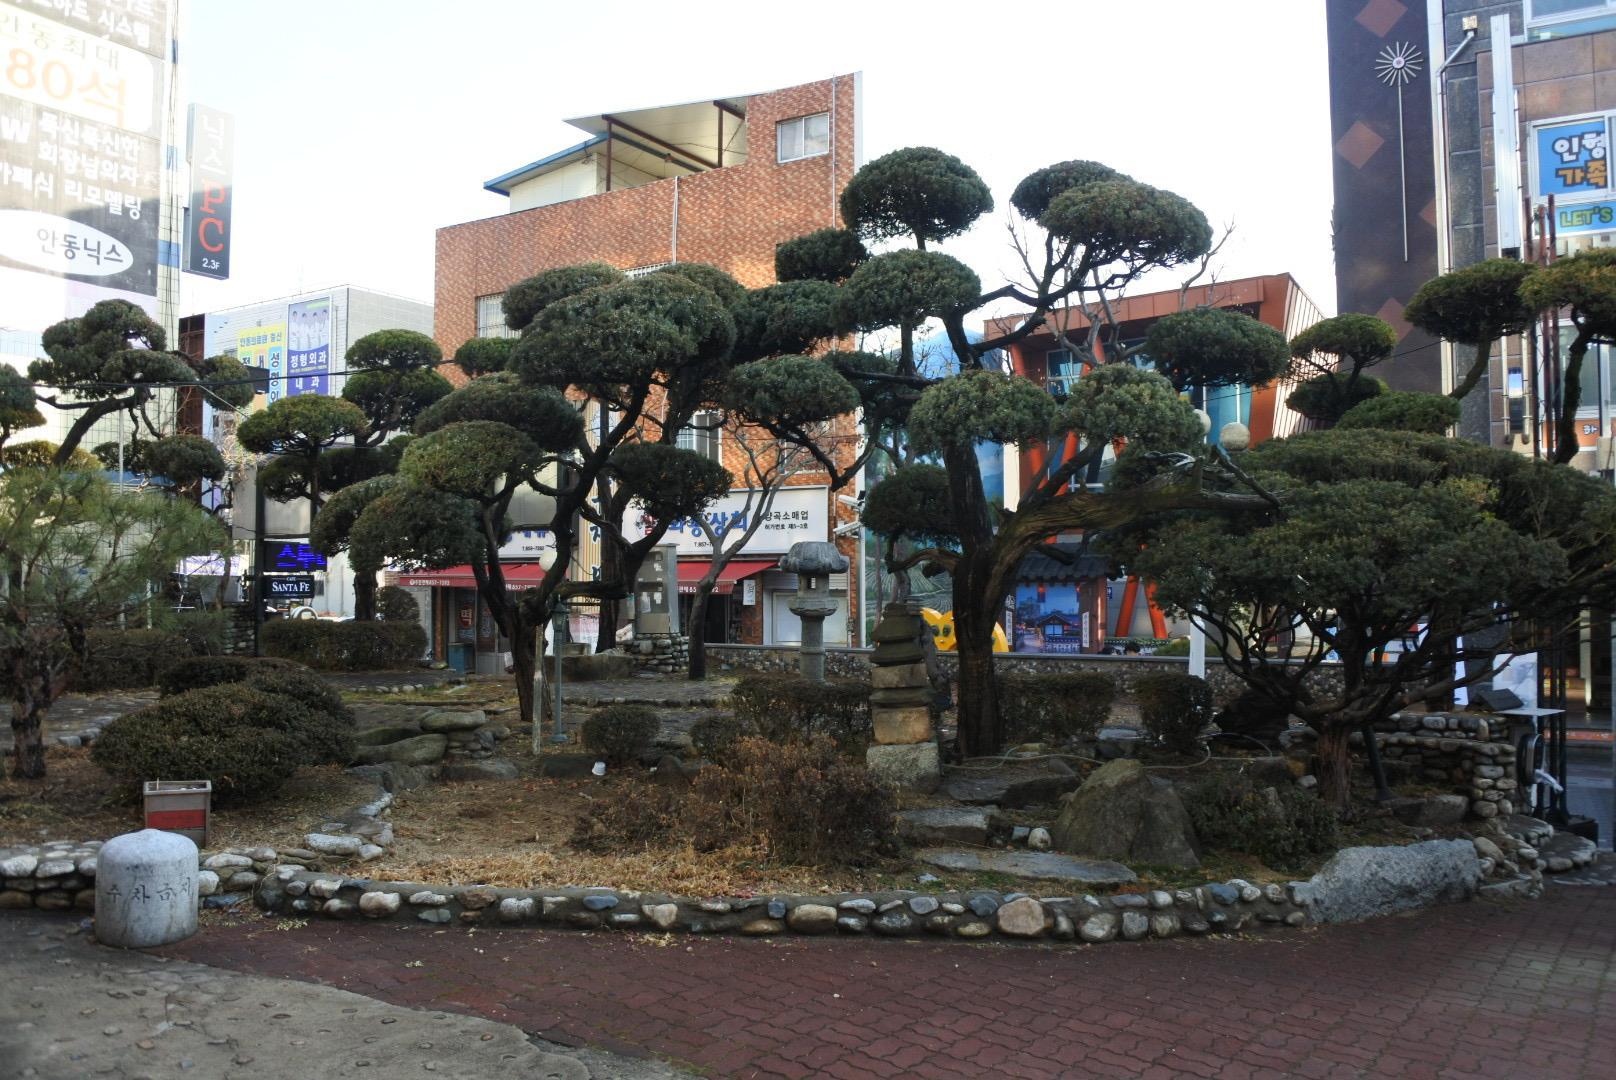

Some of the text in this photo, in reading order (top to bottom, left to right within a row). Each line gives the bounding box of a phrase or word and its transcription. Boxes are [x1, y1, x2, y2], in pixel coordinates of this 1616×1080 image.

[1555, 160, 1607, 188] 가족
[64, 178, 141, 220] 리모델링
[198, 177, 226, 253] PC
[1560, 206, 1613, 227] LET'S
[36, 228, 123, 266] 안동닉스
[291, 350, 327, 368] 정형외과
[106, 876, 194, 904] 주차금지
